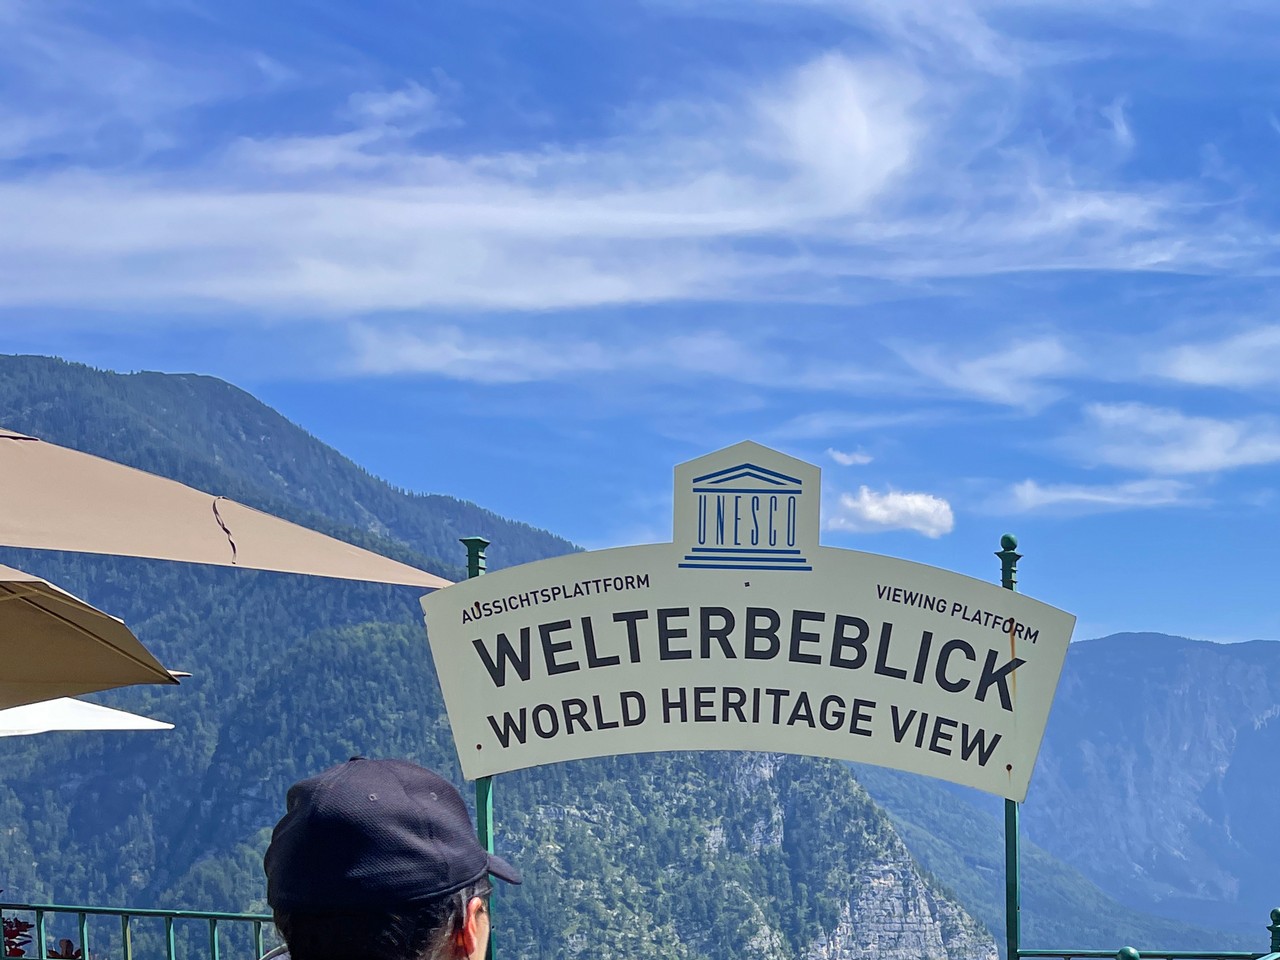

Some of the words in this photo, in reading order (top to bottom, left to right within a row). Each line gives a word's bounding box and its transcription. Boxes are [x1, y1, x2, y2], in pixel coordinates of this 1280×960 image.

[698, 495, 796, 547] UNESCO
[462, 573, 650, 624] AUSSICHTSPLATTFORM
[876, 584, 947, 614] VIEWING
[951, 602, 1040, 644] PLATFORM
[471, 606, 1027, 713] WELTERBEBLICK
[486, 690, 647, 748] WORLD
[661, 686, 876, 738] HERITAGE
[890, 704, 1002, 767] VIEW
